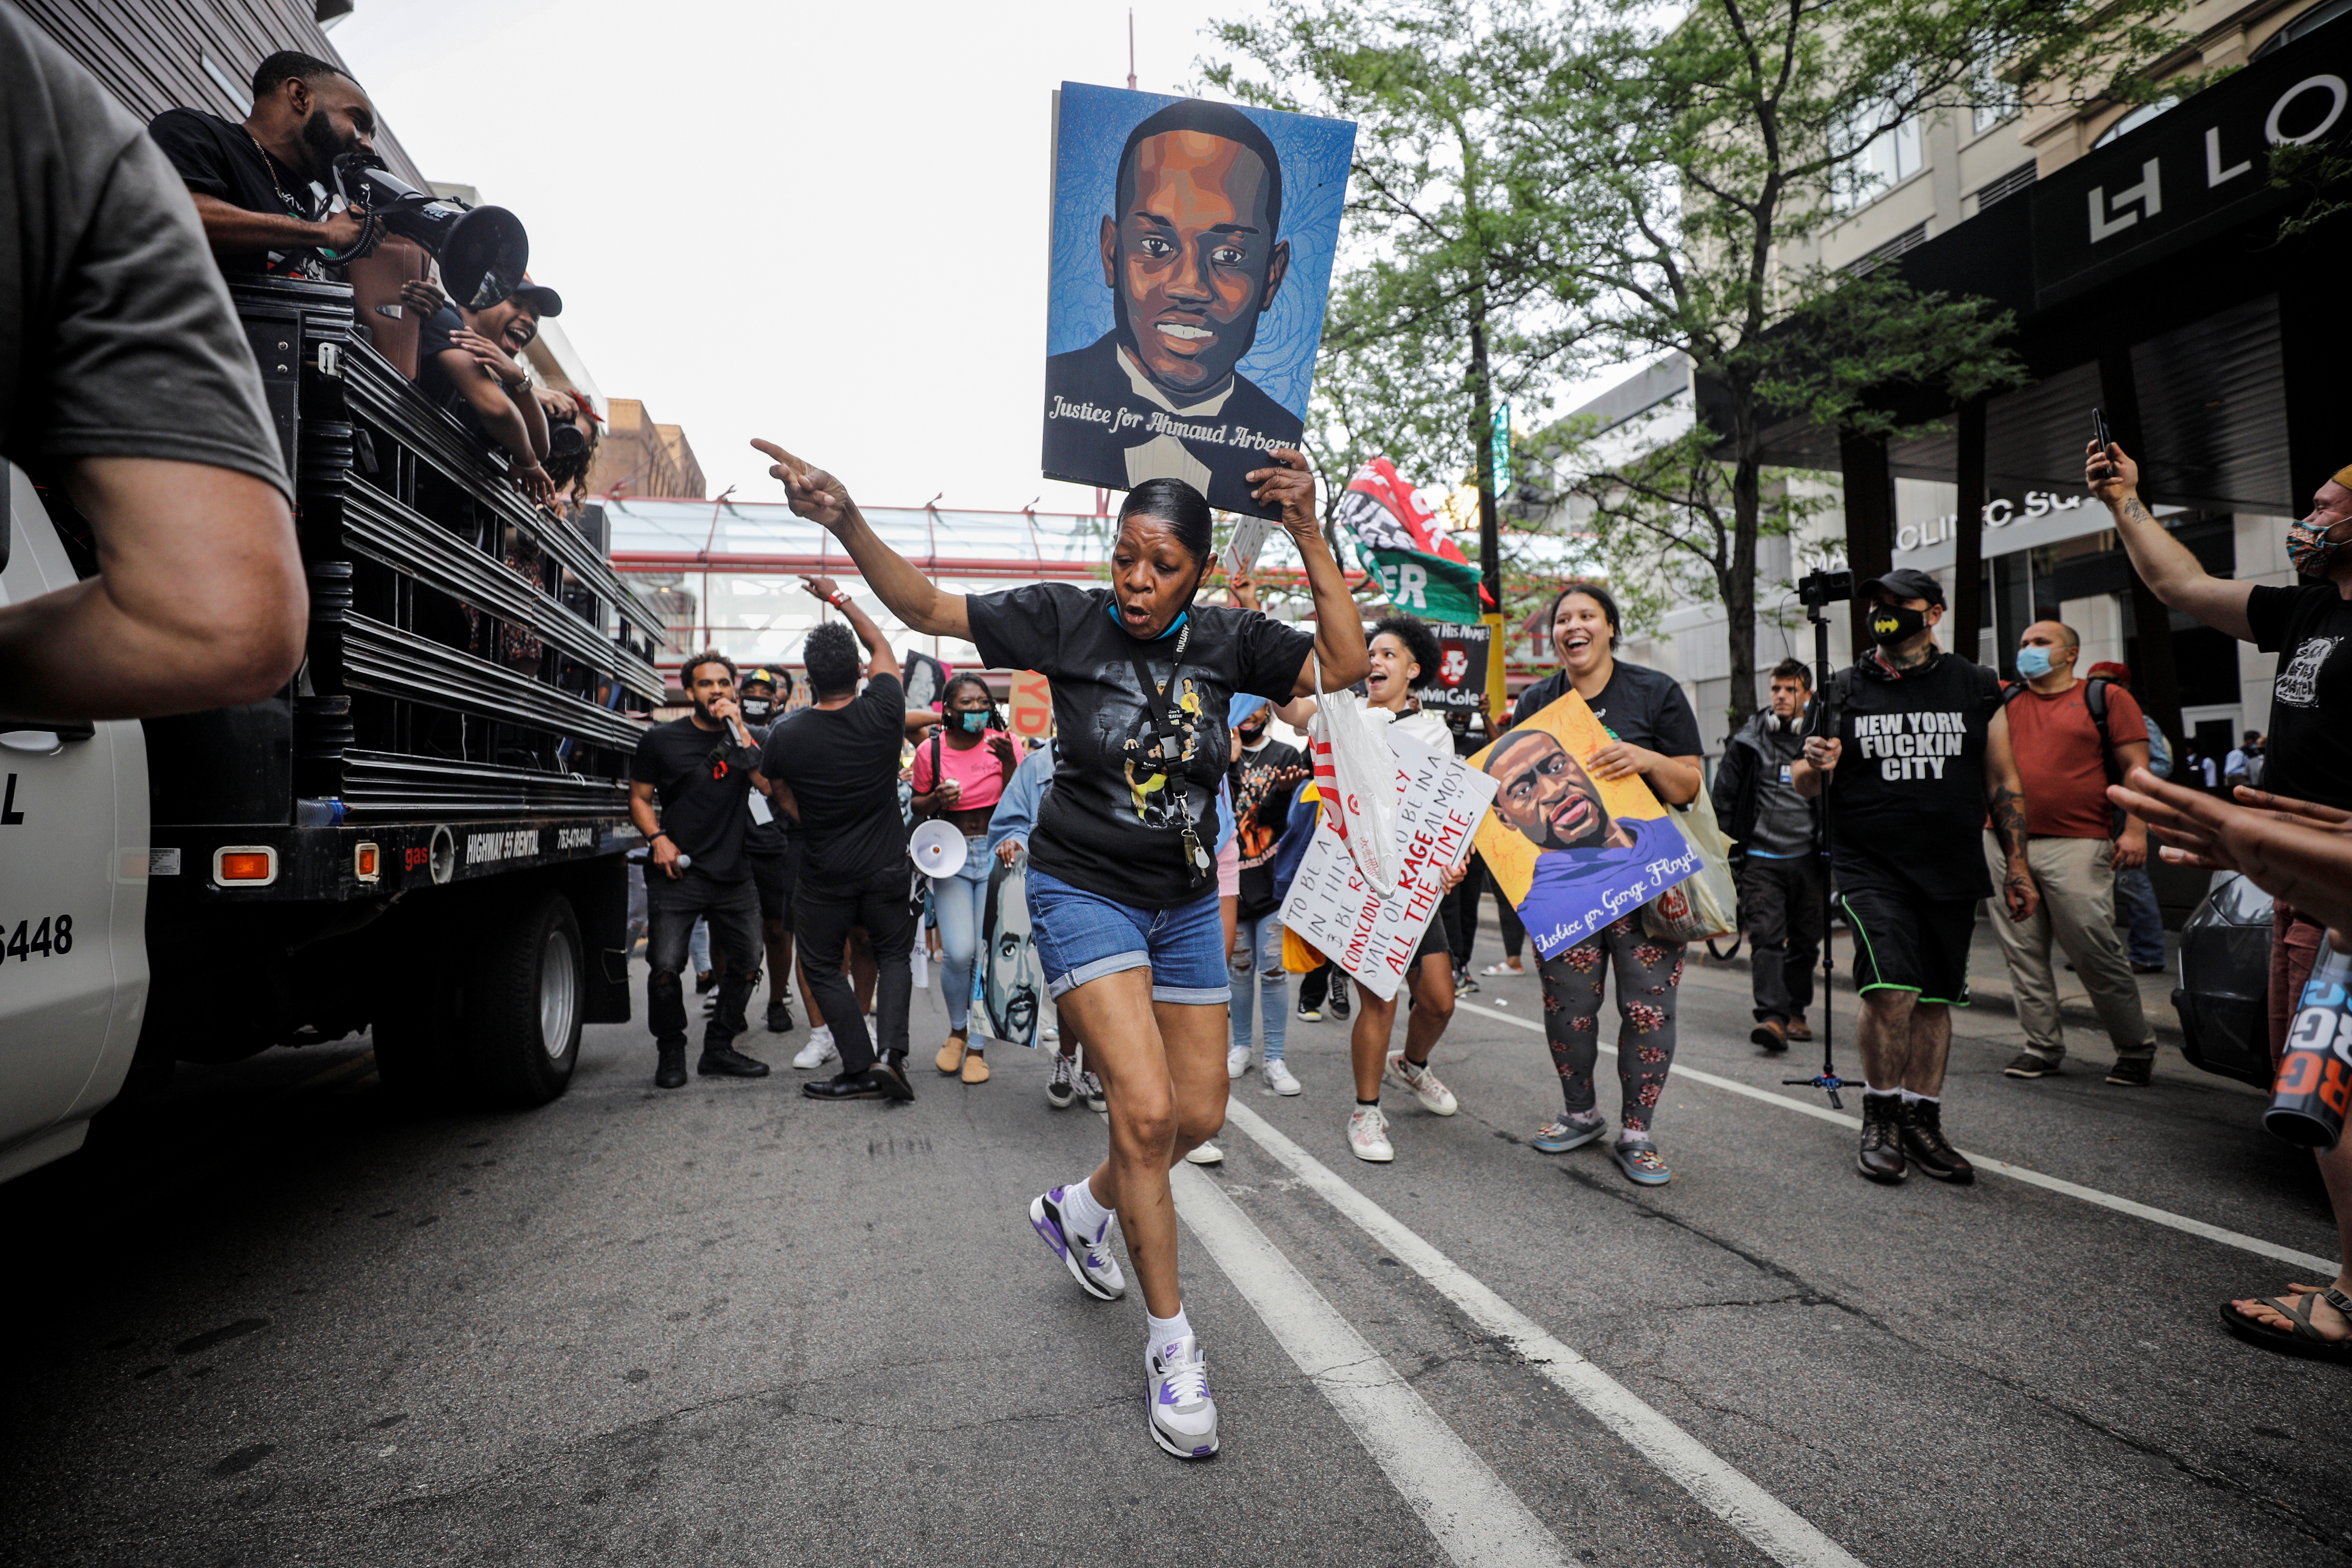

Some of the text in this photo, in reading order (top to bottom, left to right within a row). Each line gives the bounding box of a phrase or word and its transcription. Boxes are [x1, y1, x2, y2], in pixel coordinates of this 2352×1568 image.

[1048, 395, 1111, 423] Justice
[1109, 407, 1144, 433] for
[1145, 411, 1228, 444] Ahmaud
[1896, 498, 2014, 552] CLIC
[1446, 688, 1479, 707] Cole
[1855, 711, 1967, 738] NEW YORK
[1860, 733, 1963, 759] FUCKIN
[1402, 796, 1424, 825] BE
[1415, 768, 1434, 792] IN
[1428, 755, 1442, 769] A
[1881, 757, 1946, 781] CITY
[405, 847, 428, 871] gas
[466, 832, 504, 864] HIGHWAY
[503, 831, 514, 859] 55
[513, 830, 540, 857] RENTAL
[1300, 858, 1322, 891] BE
[1321, 839, 1331, 854] A
[1363, 924, 1391, 978] STATE
[1398, 829, 1435, 890] RAGE
[1424, 759, 1467, 834] ALMOST
[1308, 913, 1327, 938] IN
[1321, 849, 1351, 904] THIS
[1335, 896, 1357, 928] BE
[1535, 922, 1583, 953] Justice
[1584, 908, 1604, 932] for
[1601, 878, 1648, 915] George
[1645, 844, 1698, 887] Floyd
[0, 914, 72, 966] 448
[1386, 935, 1415, 976] ALL
[1404, 880, 1439, 923] THE
[1167, 1342, 1179, 1353] NIKE
